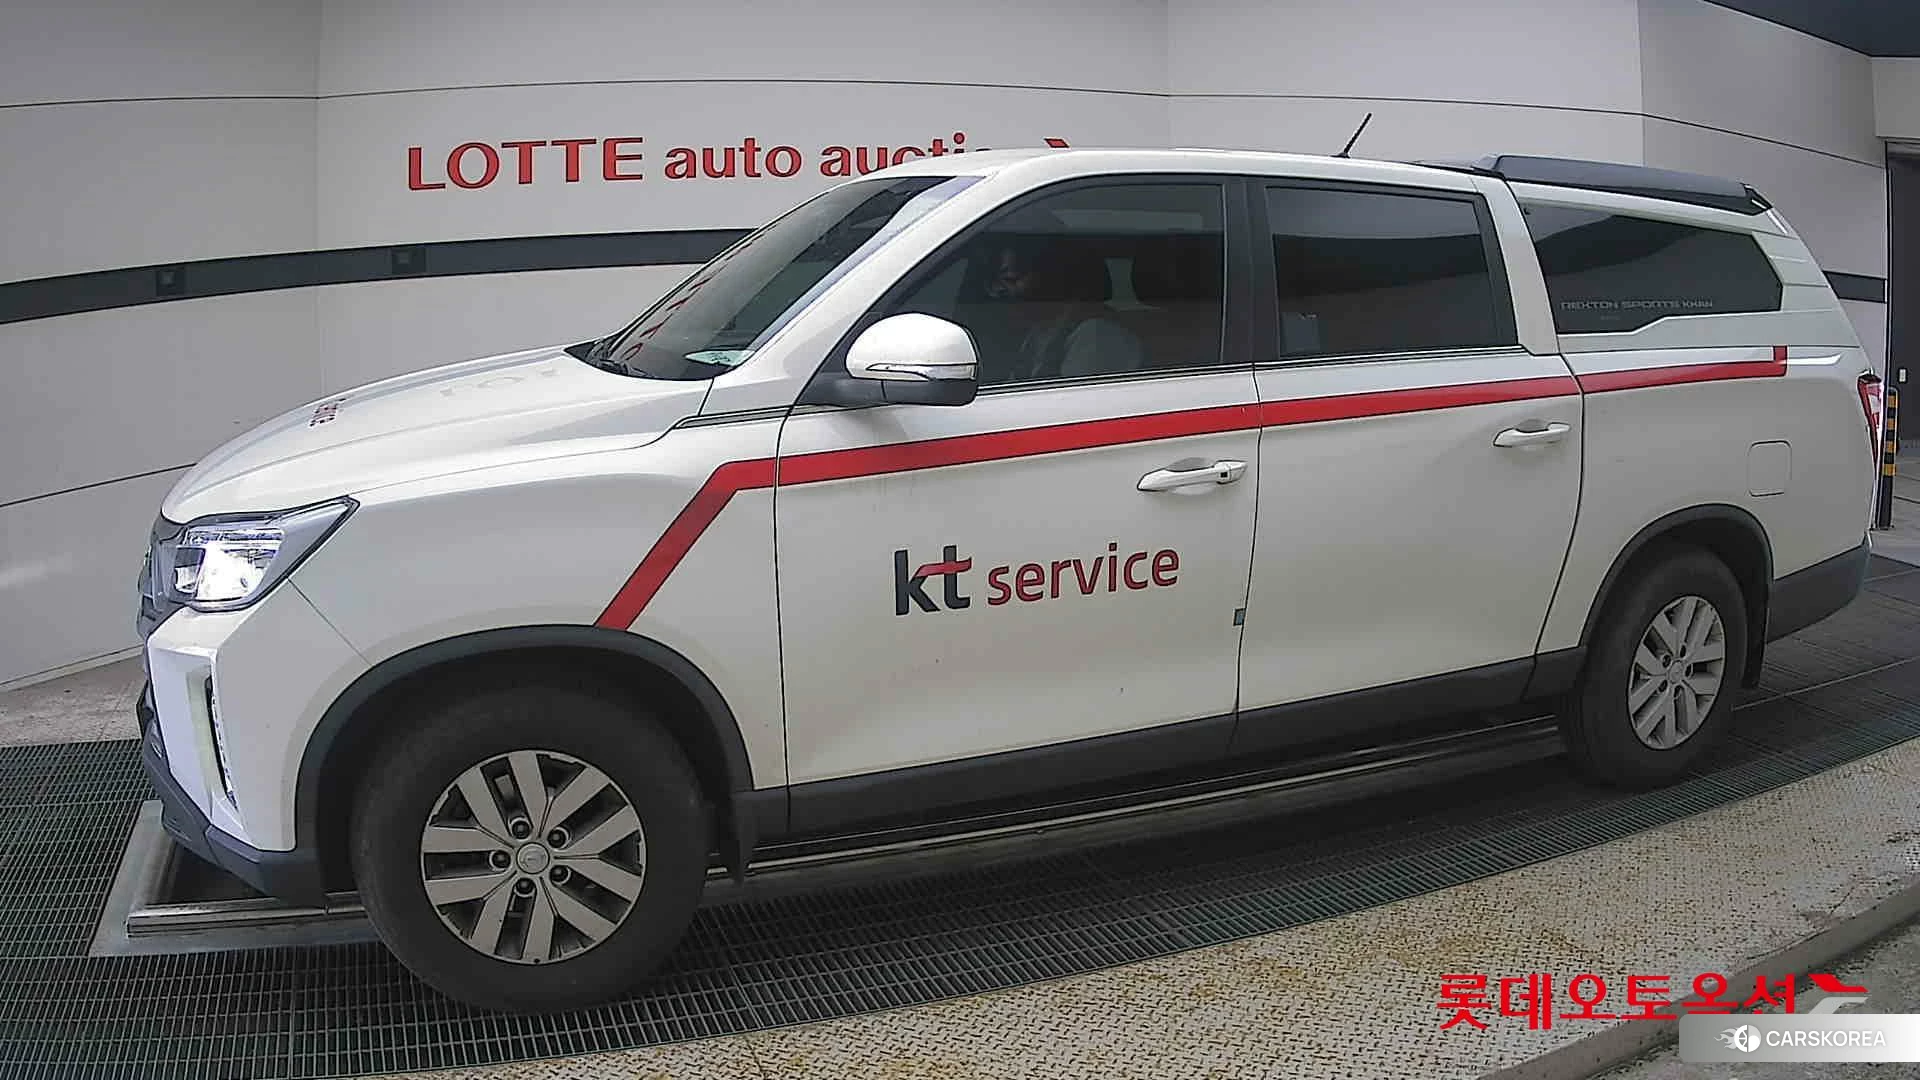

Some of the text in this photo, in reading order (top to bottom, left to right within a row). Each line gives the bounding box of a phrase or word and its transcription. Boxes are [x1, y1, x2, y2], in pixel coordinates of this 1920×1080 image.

[408, 136, 643, 192] LOTTE
[664, 137, 802, 179] auto
[894, 542, 1179, 616] kt service
